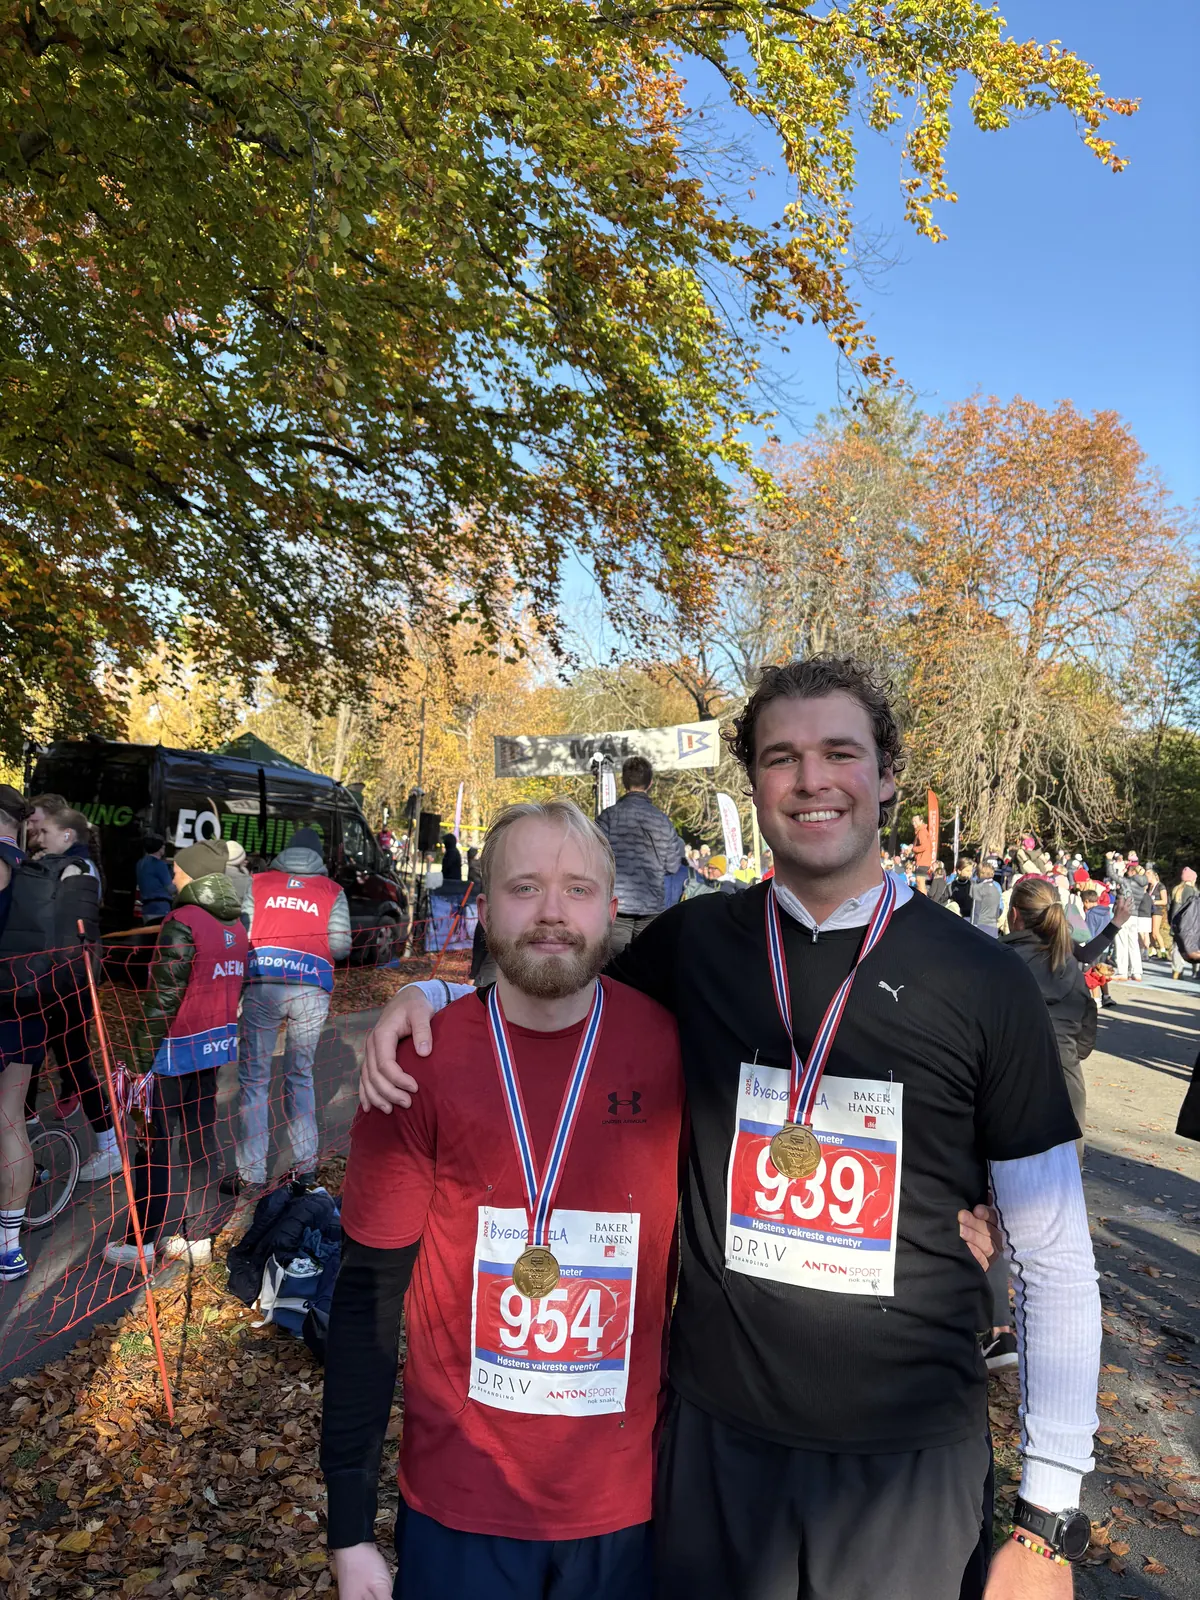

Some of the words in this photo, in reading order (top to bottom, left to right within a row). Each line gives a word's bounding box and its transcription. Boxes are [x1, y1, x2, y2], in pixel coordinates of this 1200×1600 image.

[264, 896, 319, 917] ARENA
[853, 1091, 891, 1104] BAKER
[848, 1102, 895, 1116] HANSEN
[754, 1145, 865, 1226] 939
[595, 1222, 629, 1233] BAKER
[751, 1219, 785, 1235] Høstens
[787, 1225, 824, 1242] vakreste
[826, 1233, 862, 1249] eventyr
[589, 1234, 633, 1244] HANSEN
[732, 1235, 787, 1262] DRIV
[499, 1285, 604, 1354] 954
[496, 1355, 530, 1370] Høstens
[531, 1359, 568, 1372] vakreste
[569, 1362, 600, 1373] eventyr
[478, 1368, 532, 1394] DRIV
